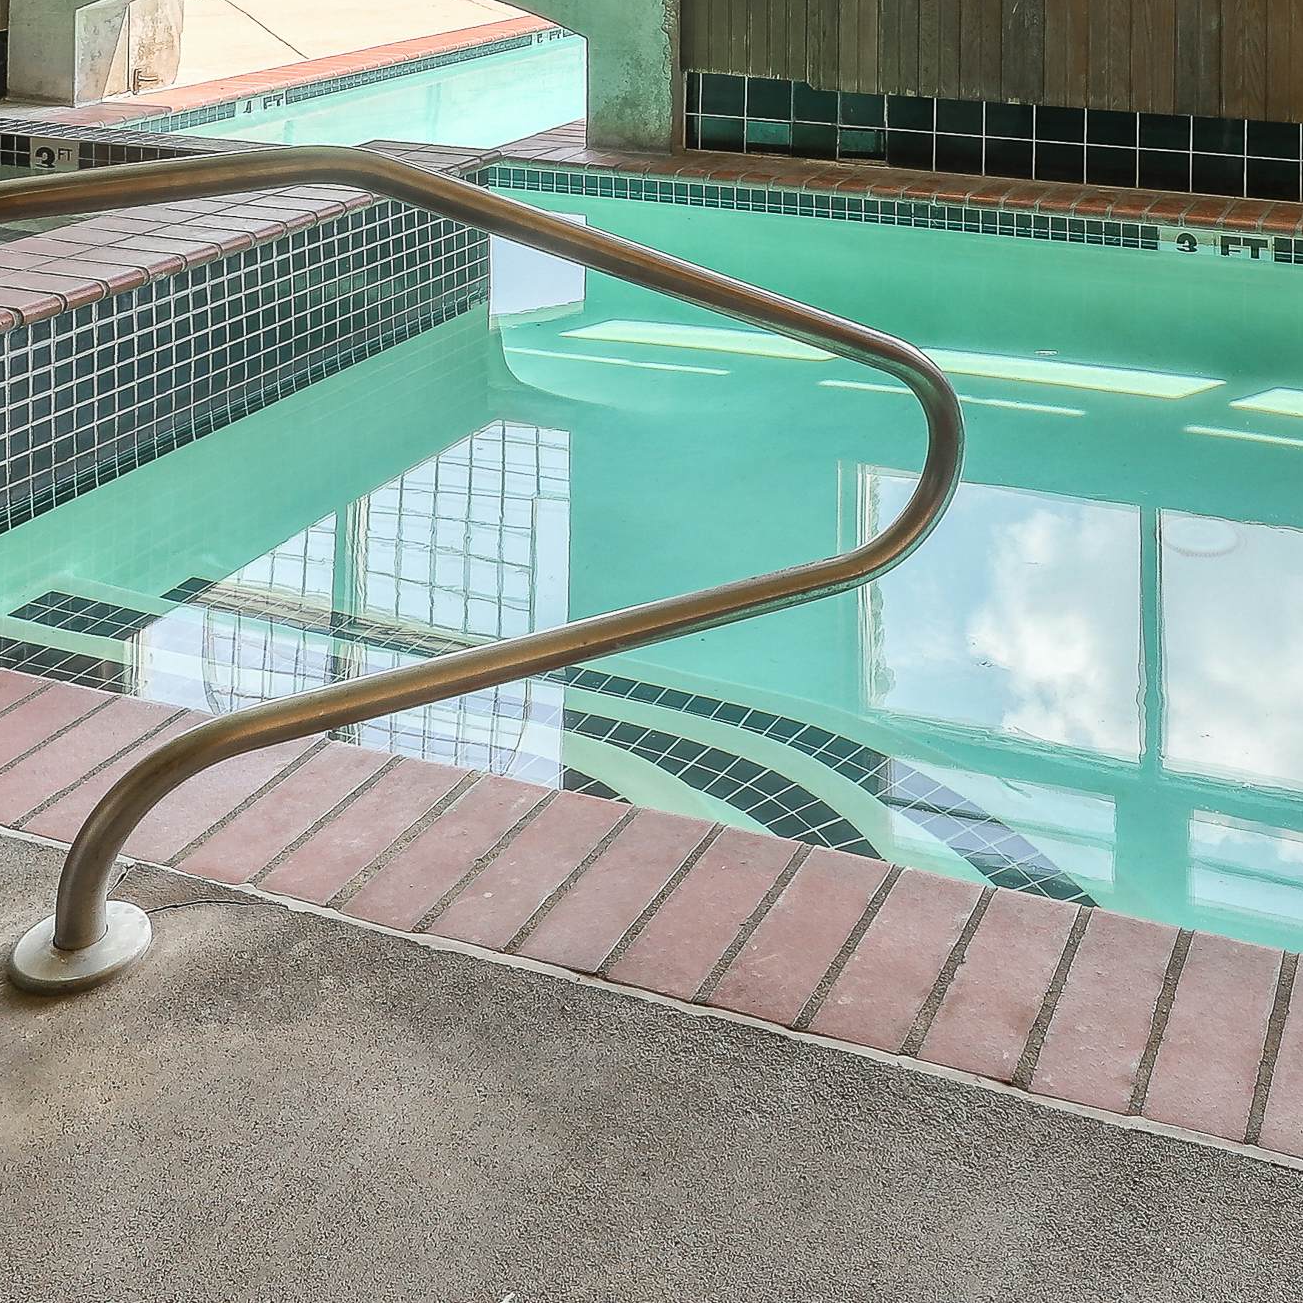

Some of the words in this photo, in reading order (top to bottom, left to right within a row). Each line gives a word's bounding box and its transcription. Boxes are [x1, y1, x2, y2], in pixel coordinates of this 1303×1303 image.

[58, 147, 73, 161] FT
[1176, 232, 1198, 252] 3
[1219, 235, 1269, 259] FT
